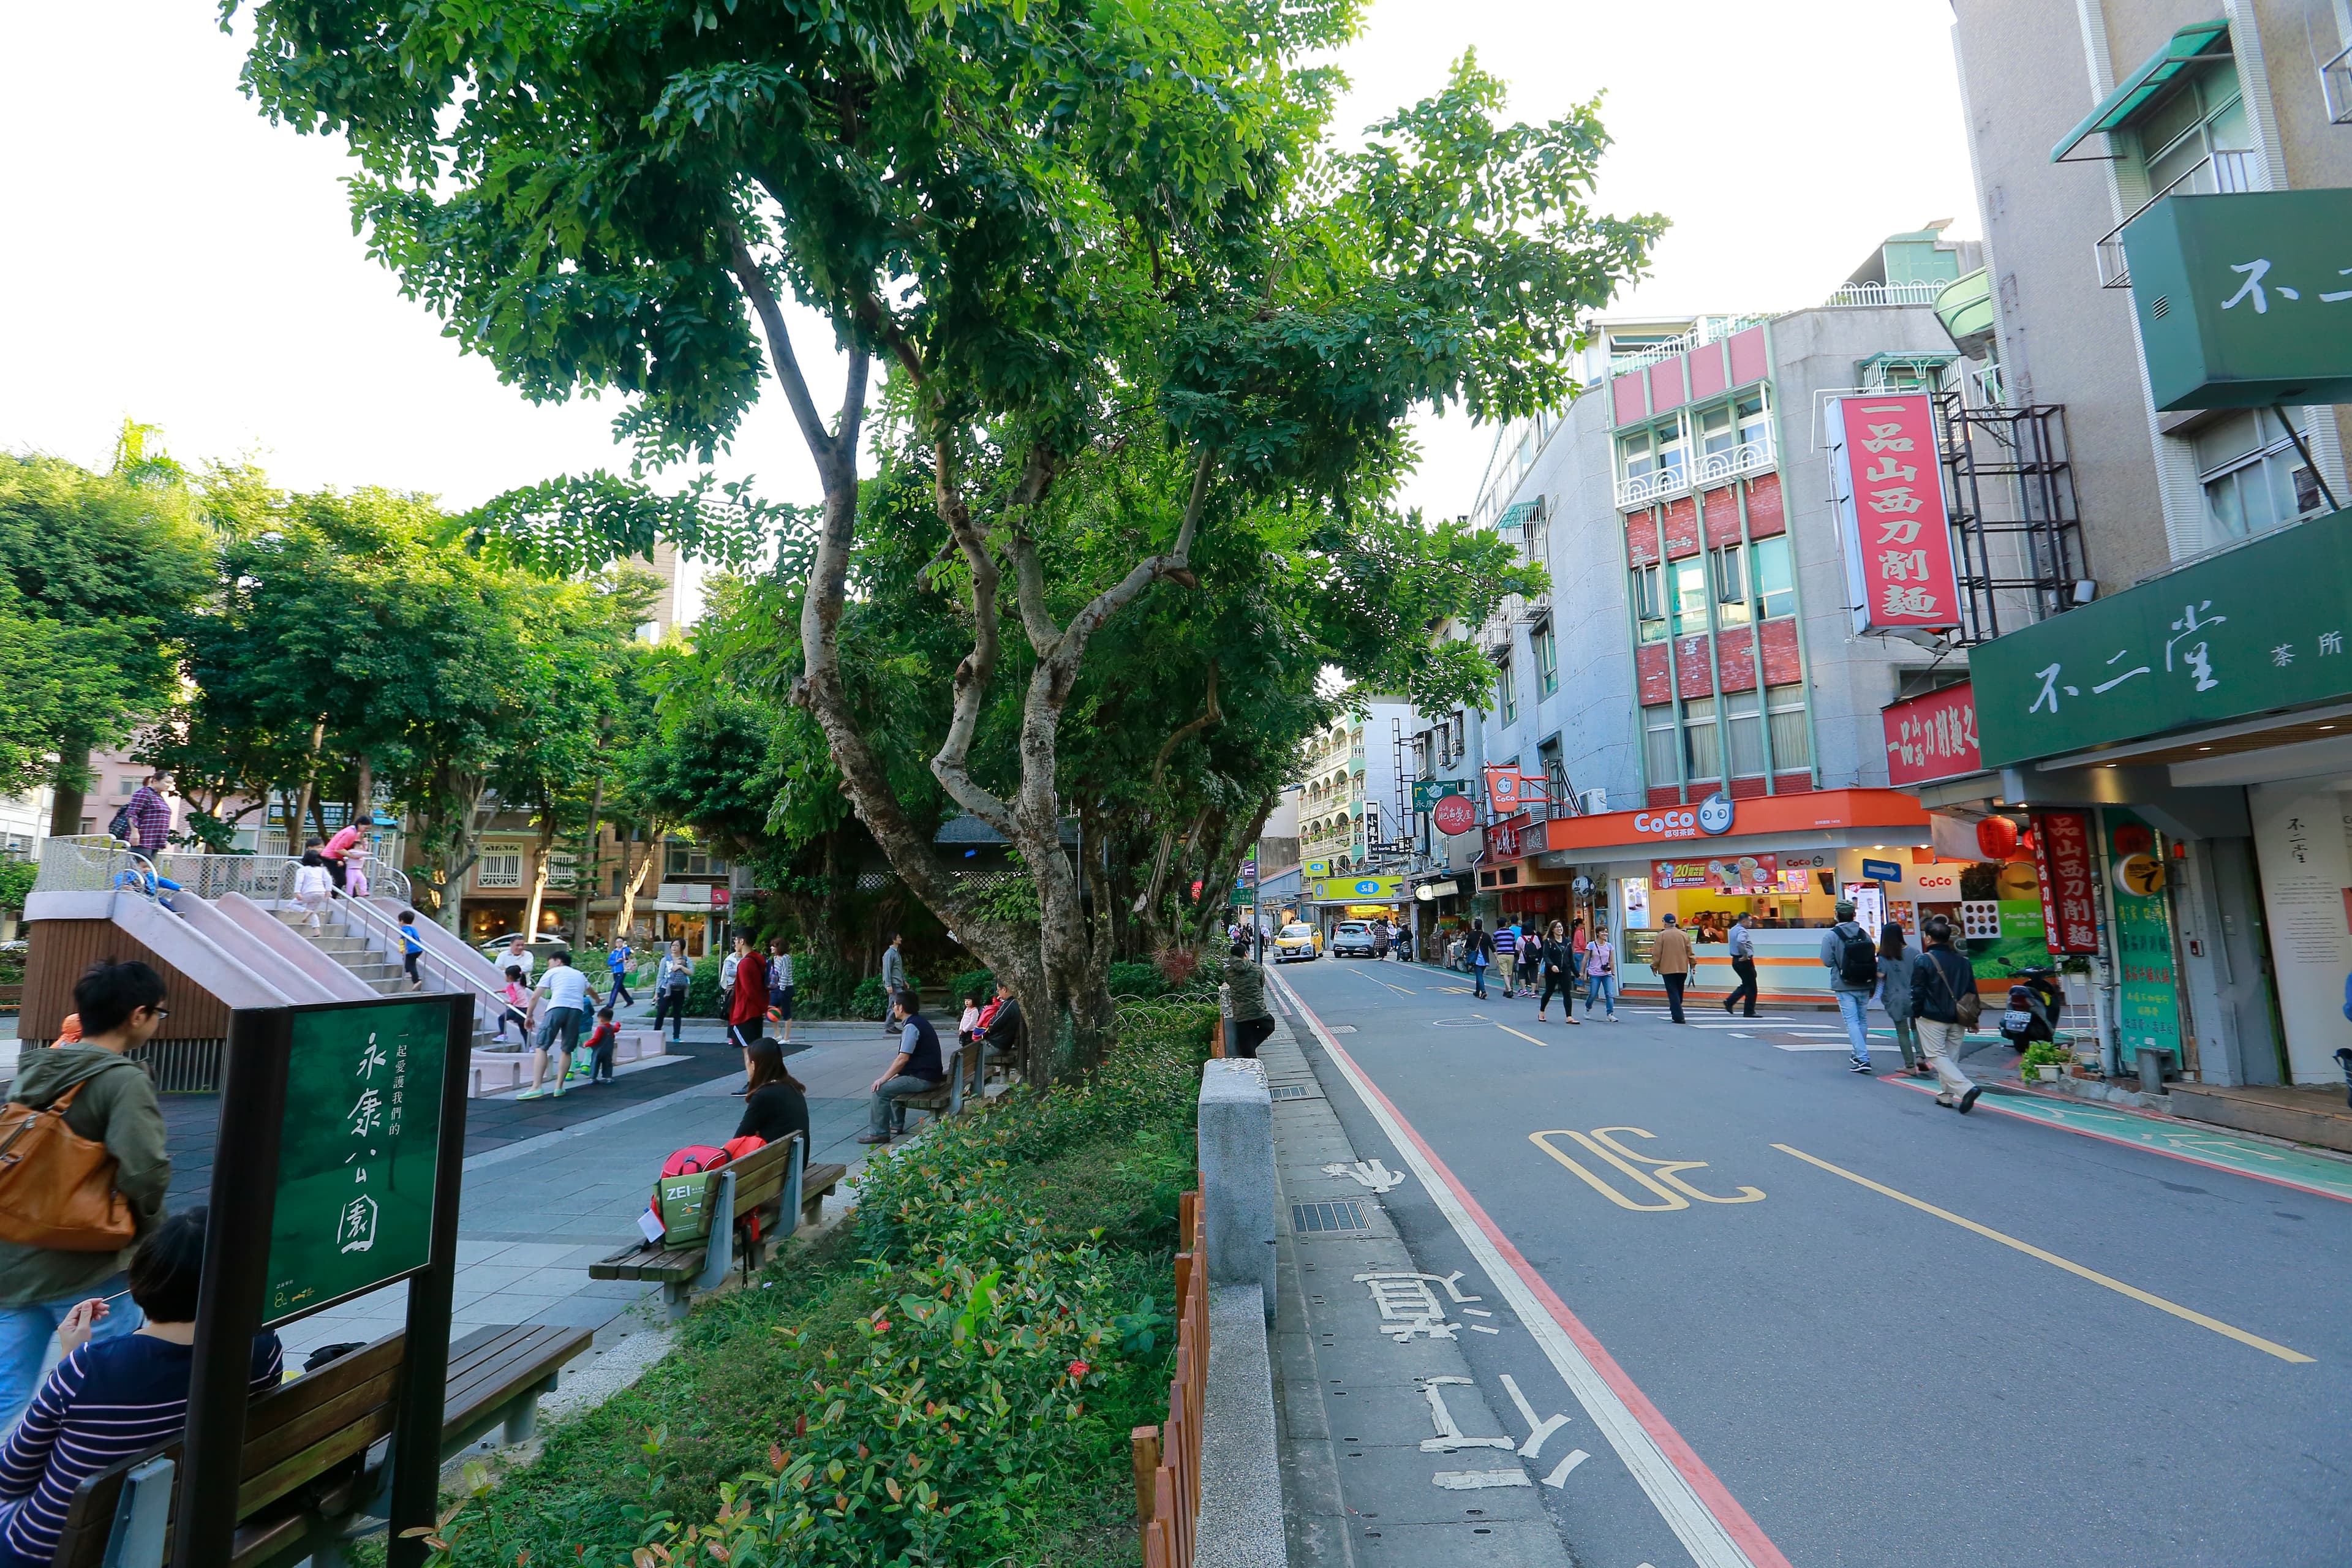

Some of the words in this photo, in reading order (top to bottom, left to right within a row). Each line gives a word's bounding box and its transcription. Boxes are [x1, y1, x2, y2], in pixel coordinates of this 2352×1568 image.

[1861, 405, 1944, 619] 一品山西刀削麵
[2029, 600, 2227, 714] 不二堂
[2270, 630, 2343, 667] 茶所
[1634, 811, 1695, 832] CoCo
[1664, 827, 1695, 838] 都可茶飲
[2288, 818, 2308, 863] 不二堂
[1919, 876, 1951, 887] CoCo
[2049, 817, 2097, 947] 品山西刀削麵
[388, 1033, 410, 1136] 一起愛護我們的
[337, 1032, 387, 1254] 永康公園
[1528, 1126, 1768, 1212] 30
[666, 1185, 691, 1201] ZEI
